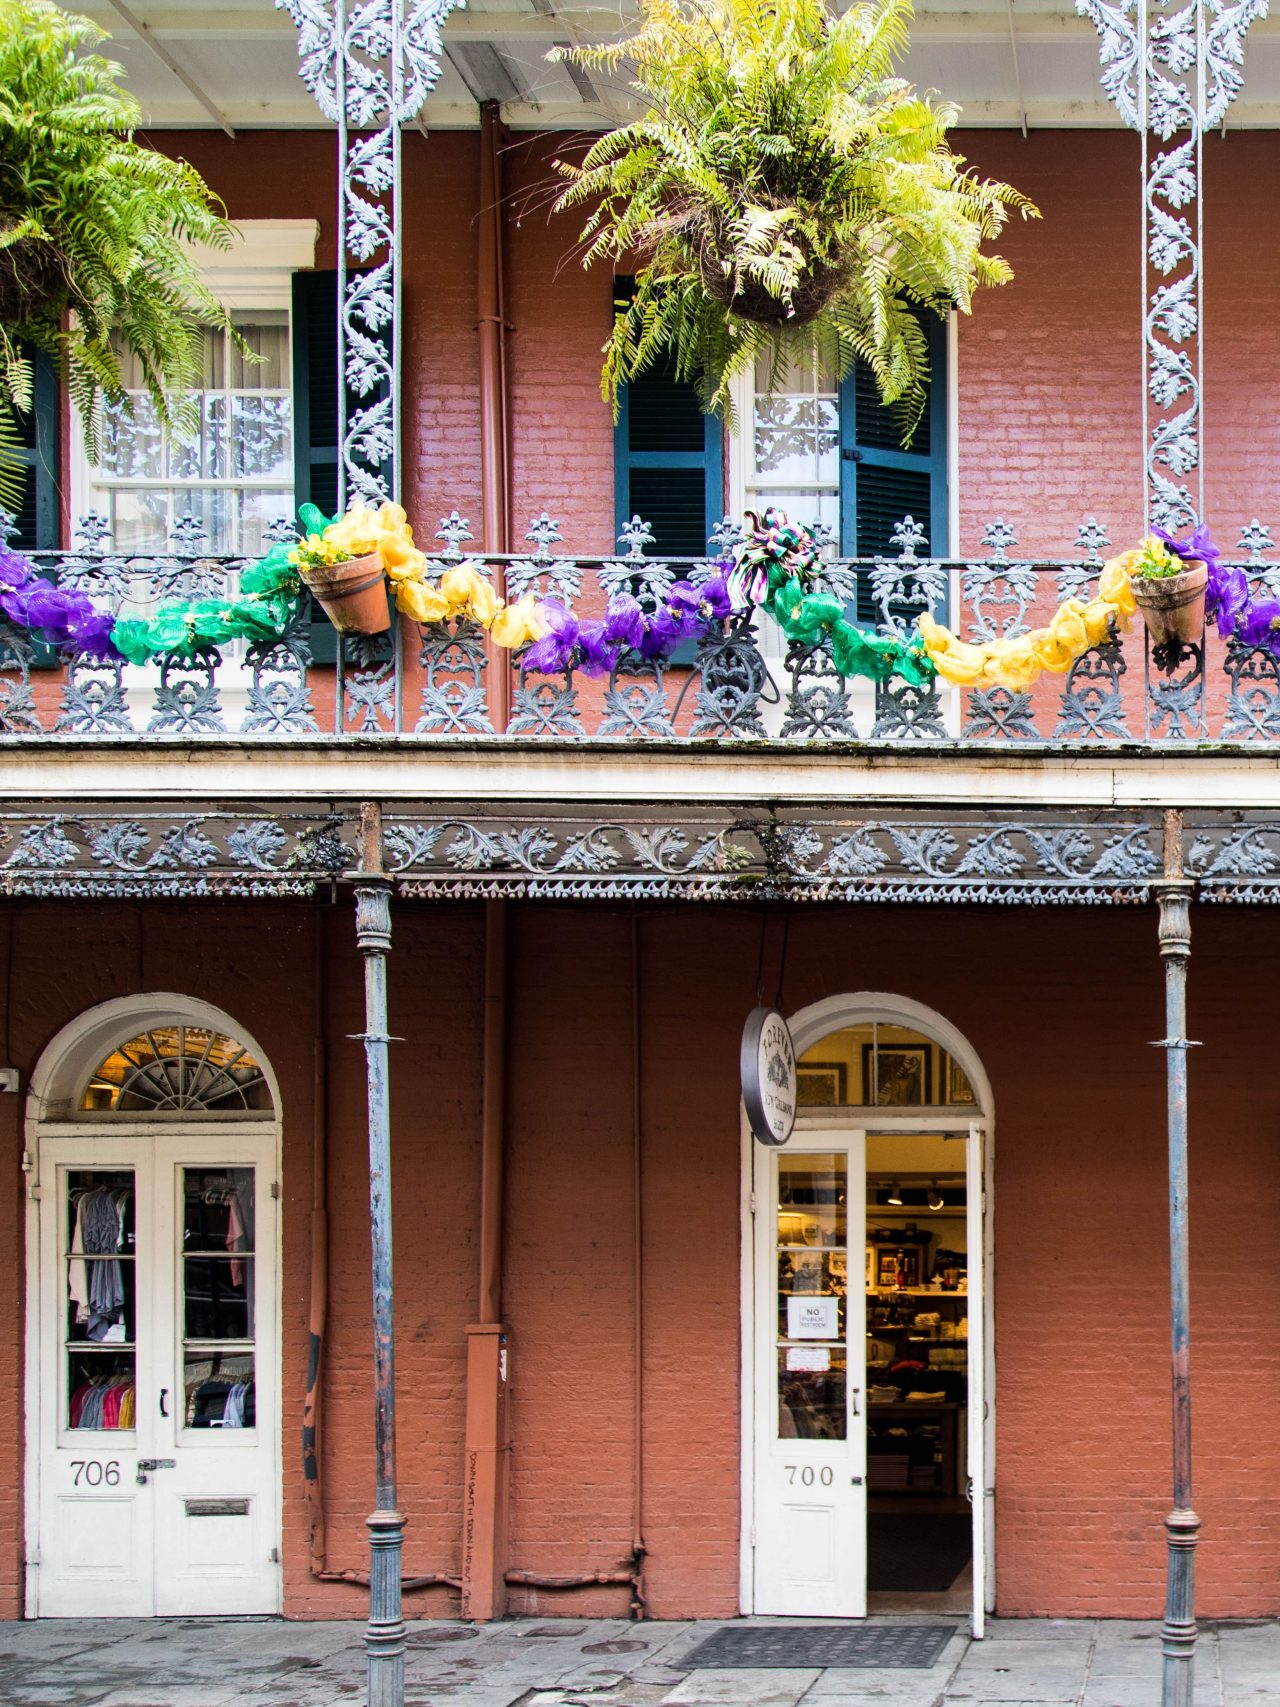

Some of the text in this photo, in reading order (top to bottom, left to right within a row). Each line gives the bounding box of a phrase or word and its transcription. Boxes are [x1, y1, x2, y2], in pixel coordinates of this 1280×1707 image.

[763, 1025, 792, 1074] FOREVER
[806, 1308, 820, 1316] NO
[70, 1460, 120, 1486] 706
[784, 1465, 834, 1486] 700
